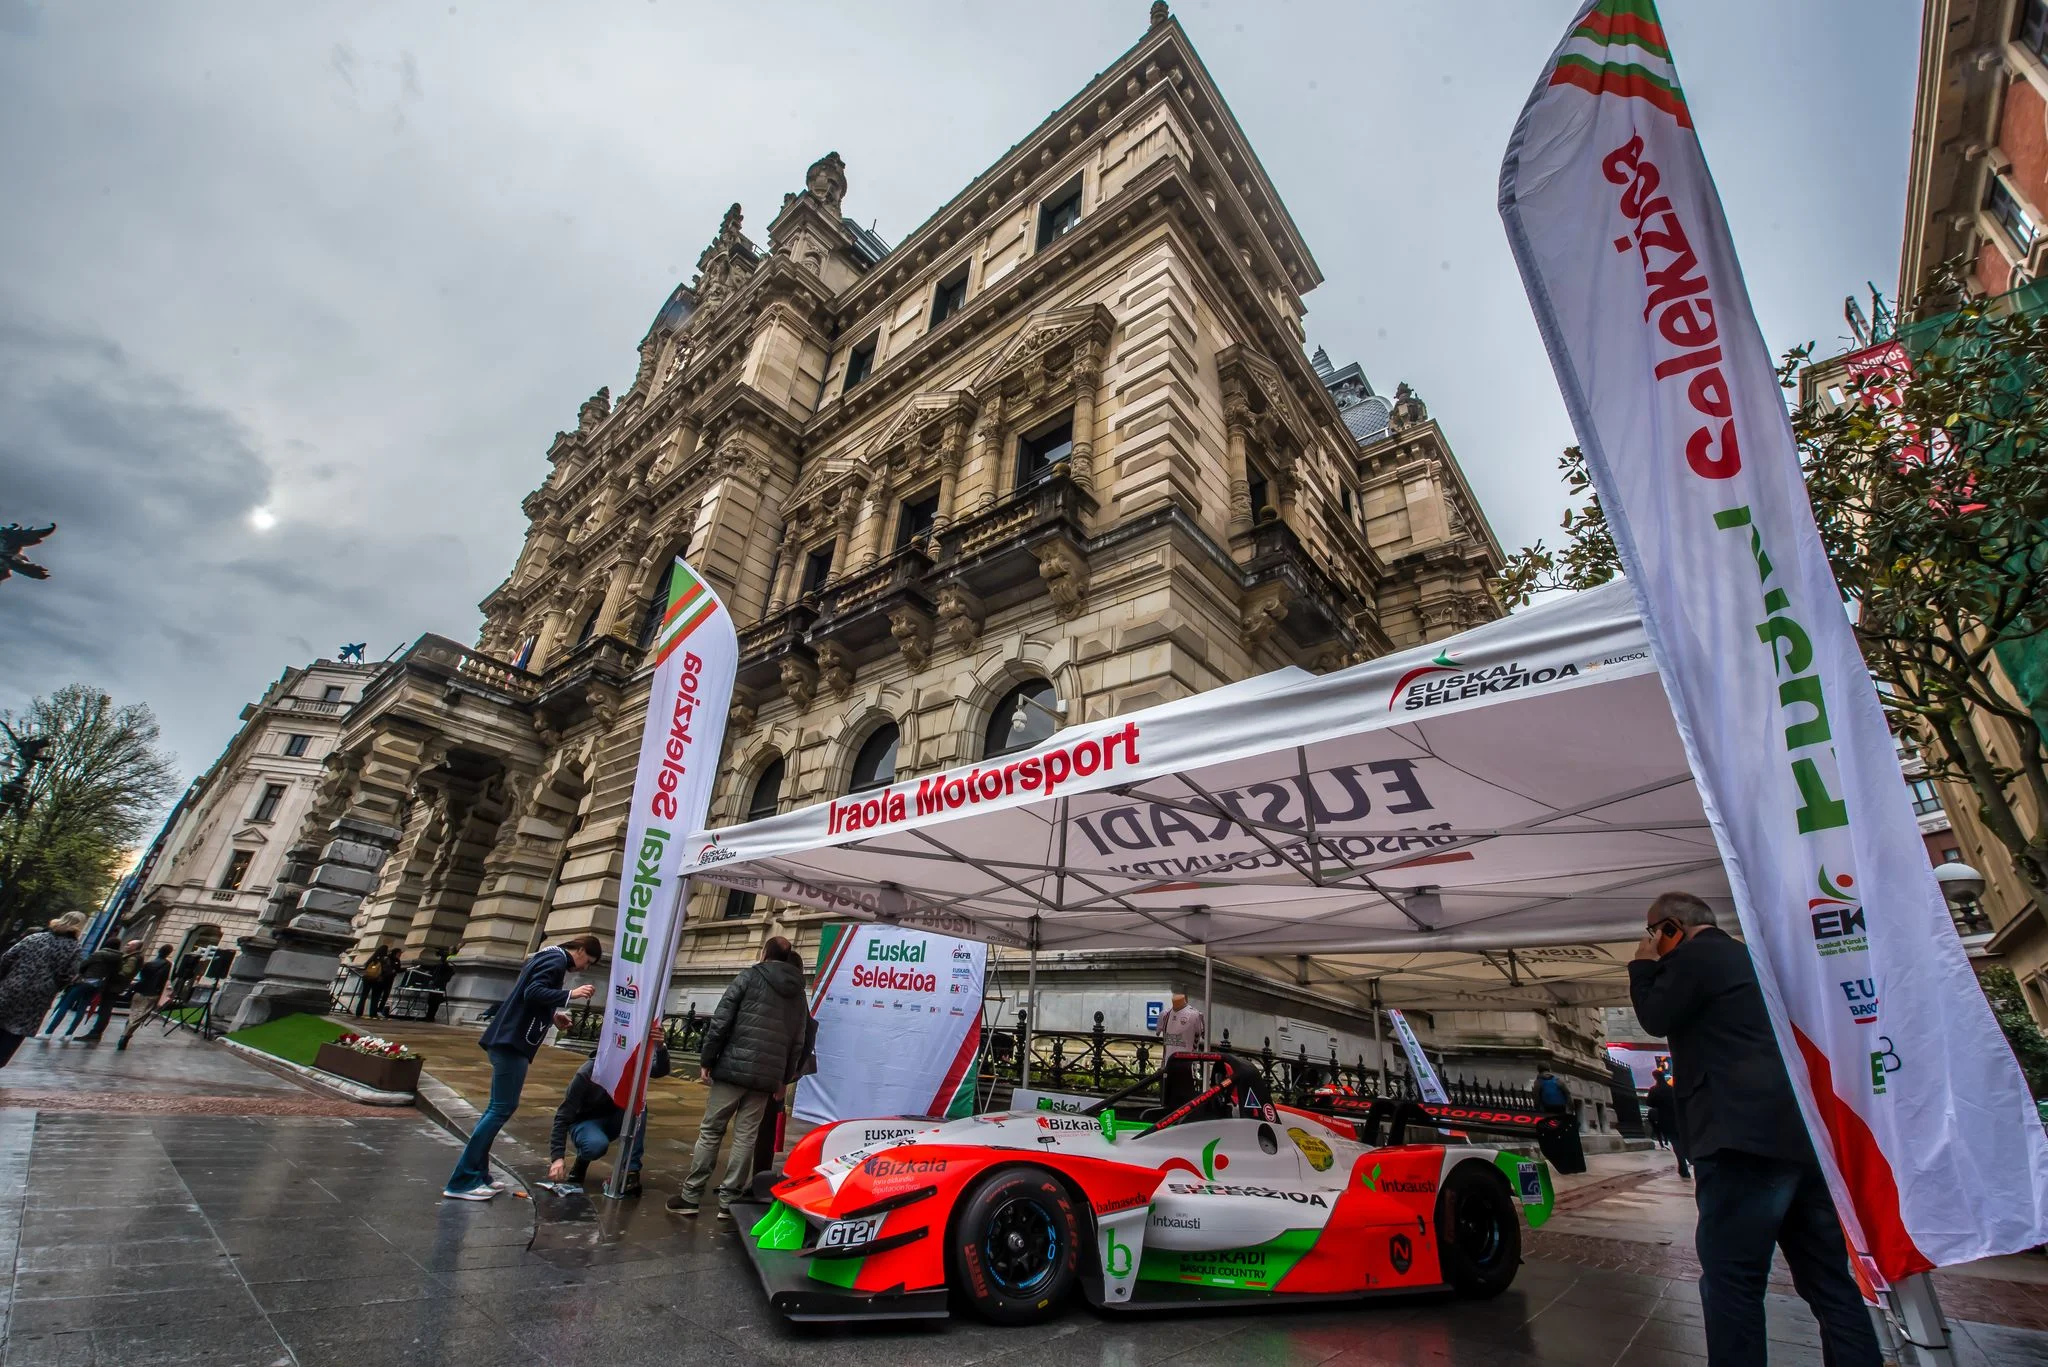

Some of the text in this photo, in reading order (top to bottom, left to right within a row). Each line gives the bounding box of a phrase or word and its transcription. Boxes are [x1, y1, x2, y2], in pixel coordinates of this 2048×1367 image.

[1603, 652, 1649, 665] ALUCISOL
[1405, 663, 1579, 711] SELEKZIOA
[1408, 662, 1526, 698] EUSKAL
[828, 722, 1140, 835] Iraola Motorsport
[867, 939, 927, 963] Euskal
[953, 952, 971, 960] EKFB
[851, 964, 937, 993] Selekzioa
[1049, 1118, 1102, 1131] Bizkaia
[876, 1157, 947, 1178] Bizkaia
[1096, 1192, 1147, 1213] balmaseda
[1152, 1215, 1201, 1229] Intxausti
[1217, 1267, 1267, 1279] COUNTRY
